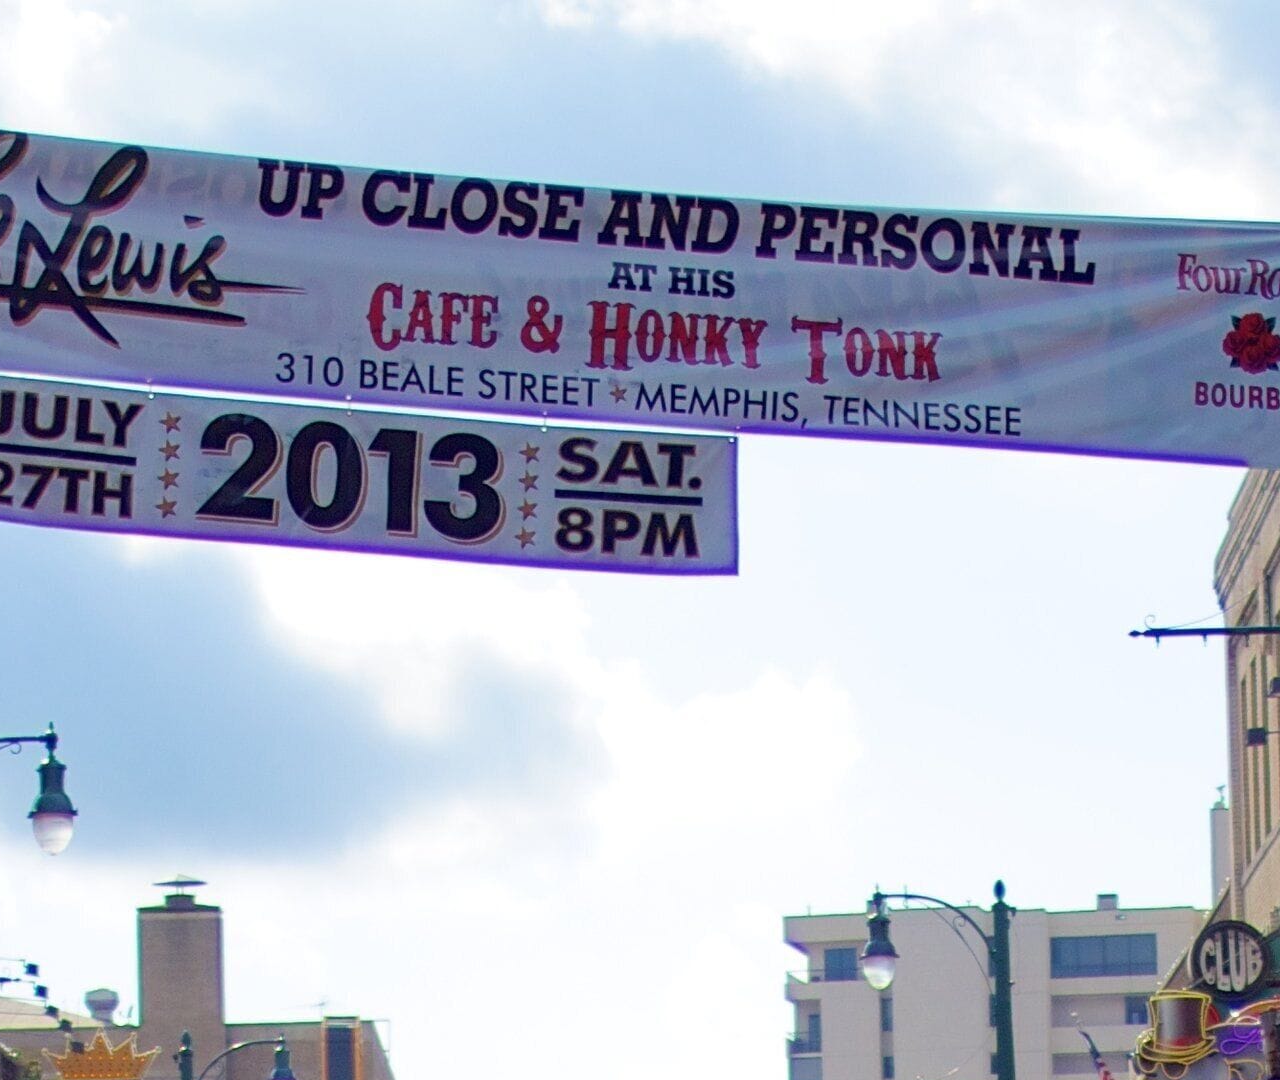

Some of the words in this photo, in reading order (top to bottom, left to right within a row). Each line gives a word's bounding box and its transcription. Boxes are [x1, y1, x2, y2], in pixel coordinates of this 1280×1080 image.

[18, 145, 230, 348] Lewis
[257, 159, 345, 220] UP
[361, 170, 585, 242] CLOSE
[597, 189, 740, 253] AND
[755, 202, 1097, 287] PERSONAL
[608, 261, 661, 292] AT
[668, 267, 736, 299] HIS
[366, 281, 500, 351] CAFE
[520, 295, 564, 355] &
[586, 299, 768, 371] HONKY
[791, 313, 943, 385] TONK
[275, 352, 345, 389] 310
[360, 360, 465, 397] BEALE
[478, 368, 601, 408] STREET
[634, 382, 809, 431] MEMPHIS,
[826, 397, 1022, 436] TENNESSEE
[195, 412, 506, 545] 2013
[557, 436, 704, 491] SAT.
[554, 506, 700, 560] 8PM
[1200, 933, 1264, 992] CLUB
